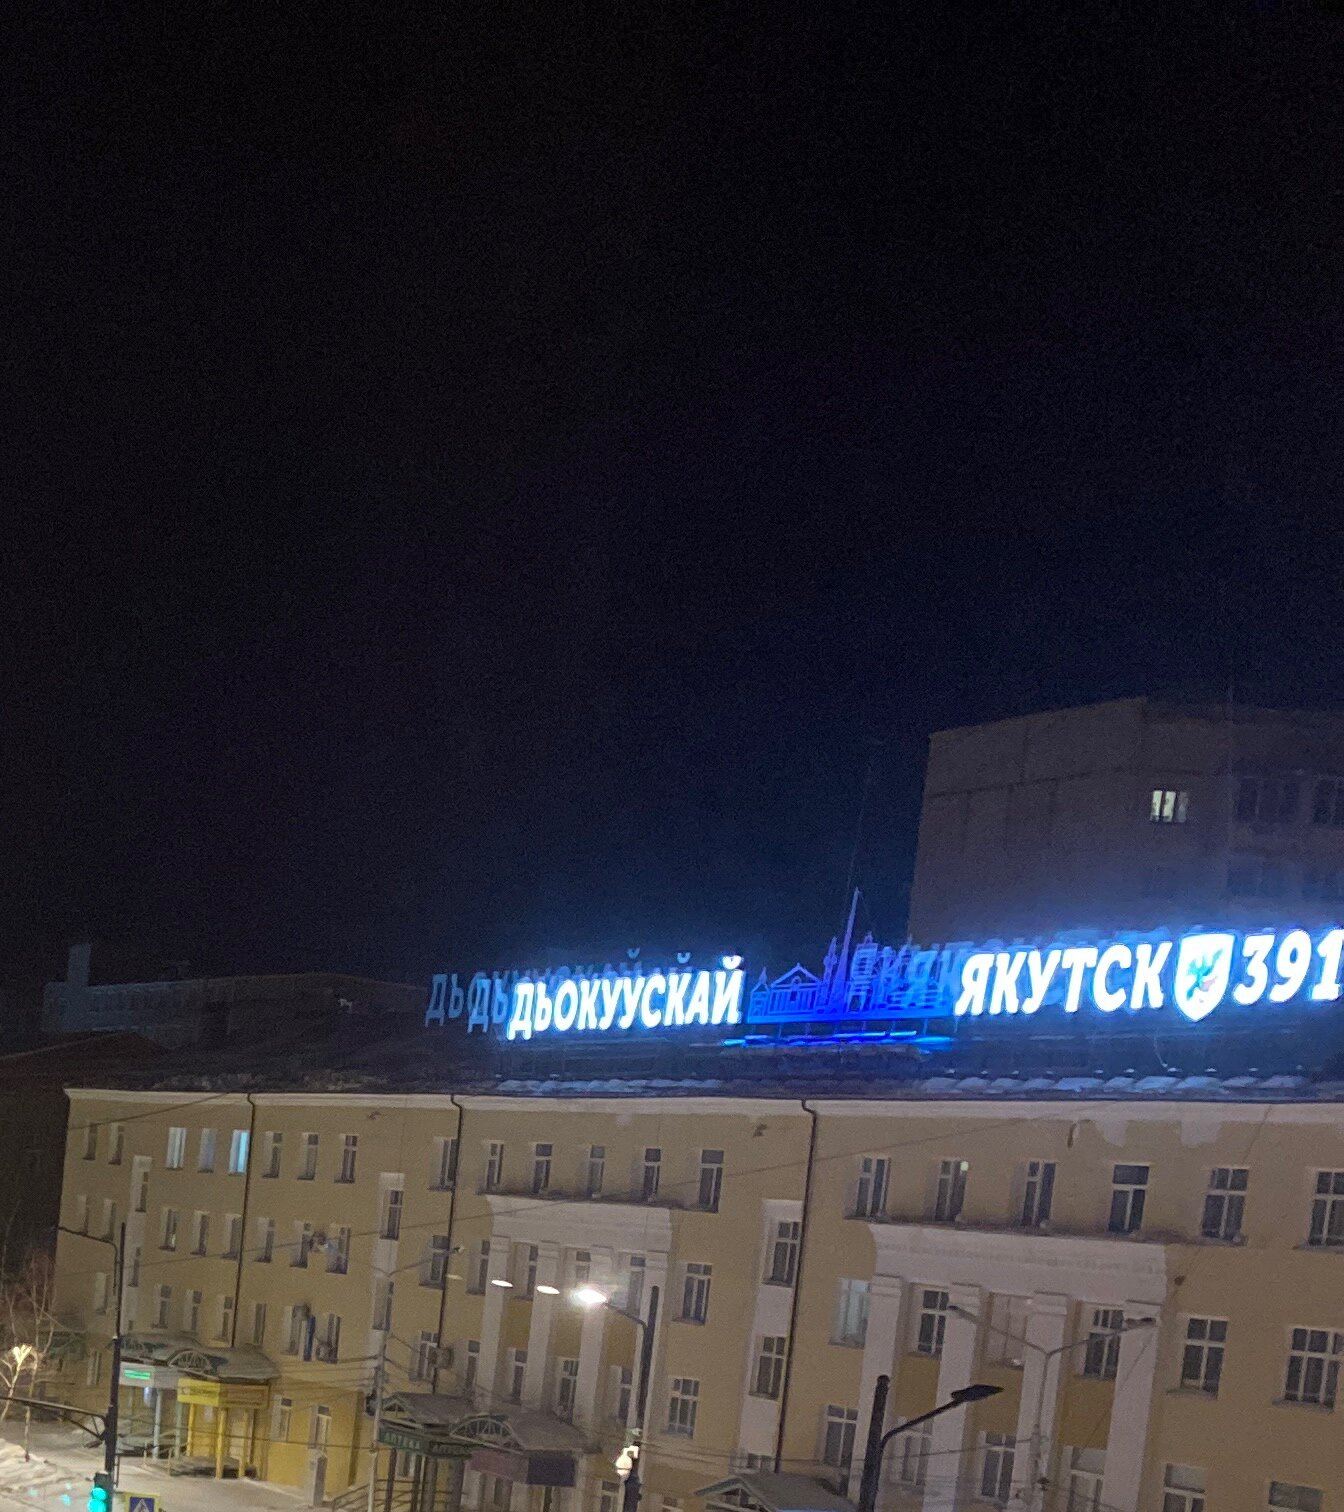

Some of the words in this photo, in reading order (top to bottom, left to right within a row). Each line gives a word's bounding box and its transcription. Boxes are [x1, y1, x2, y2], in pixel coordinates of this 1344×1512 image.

[506, 955, 744, 1041] ДЬОКУУСКАЙ
[954, 940, 1173, 1017] ЯКУТСК
[1232, 928, 1344, 1006] 391
